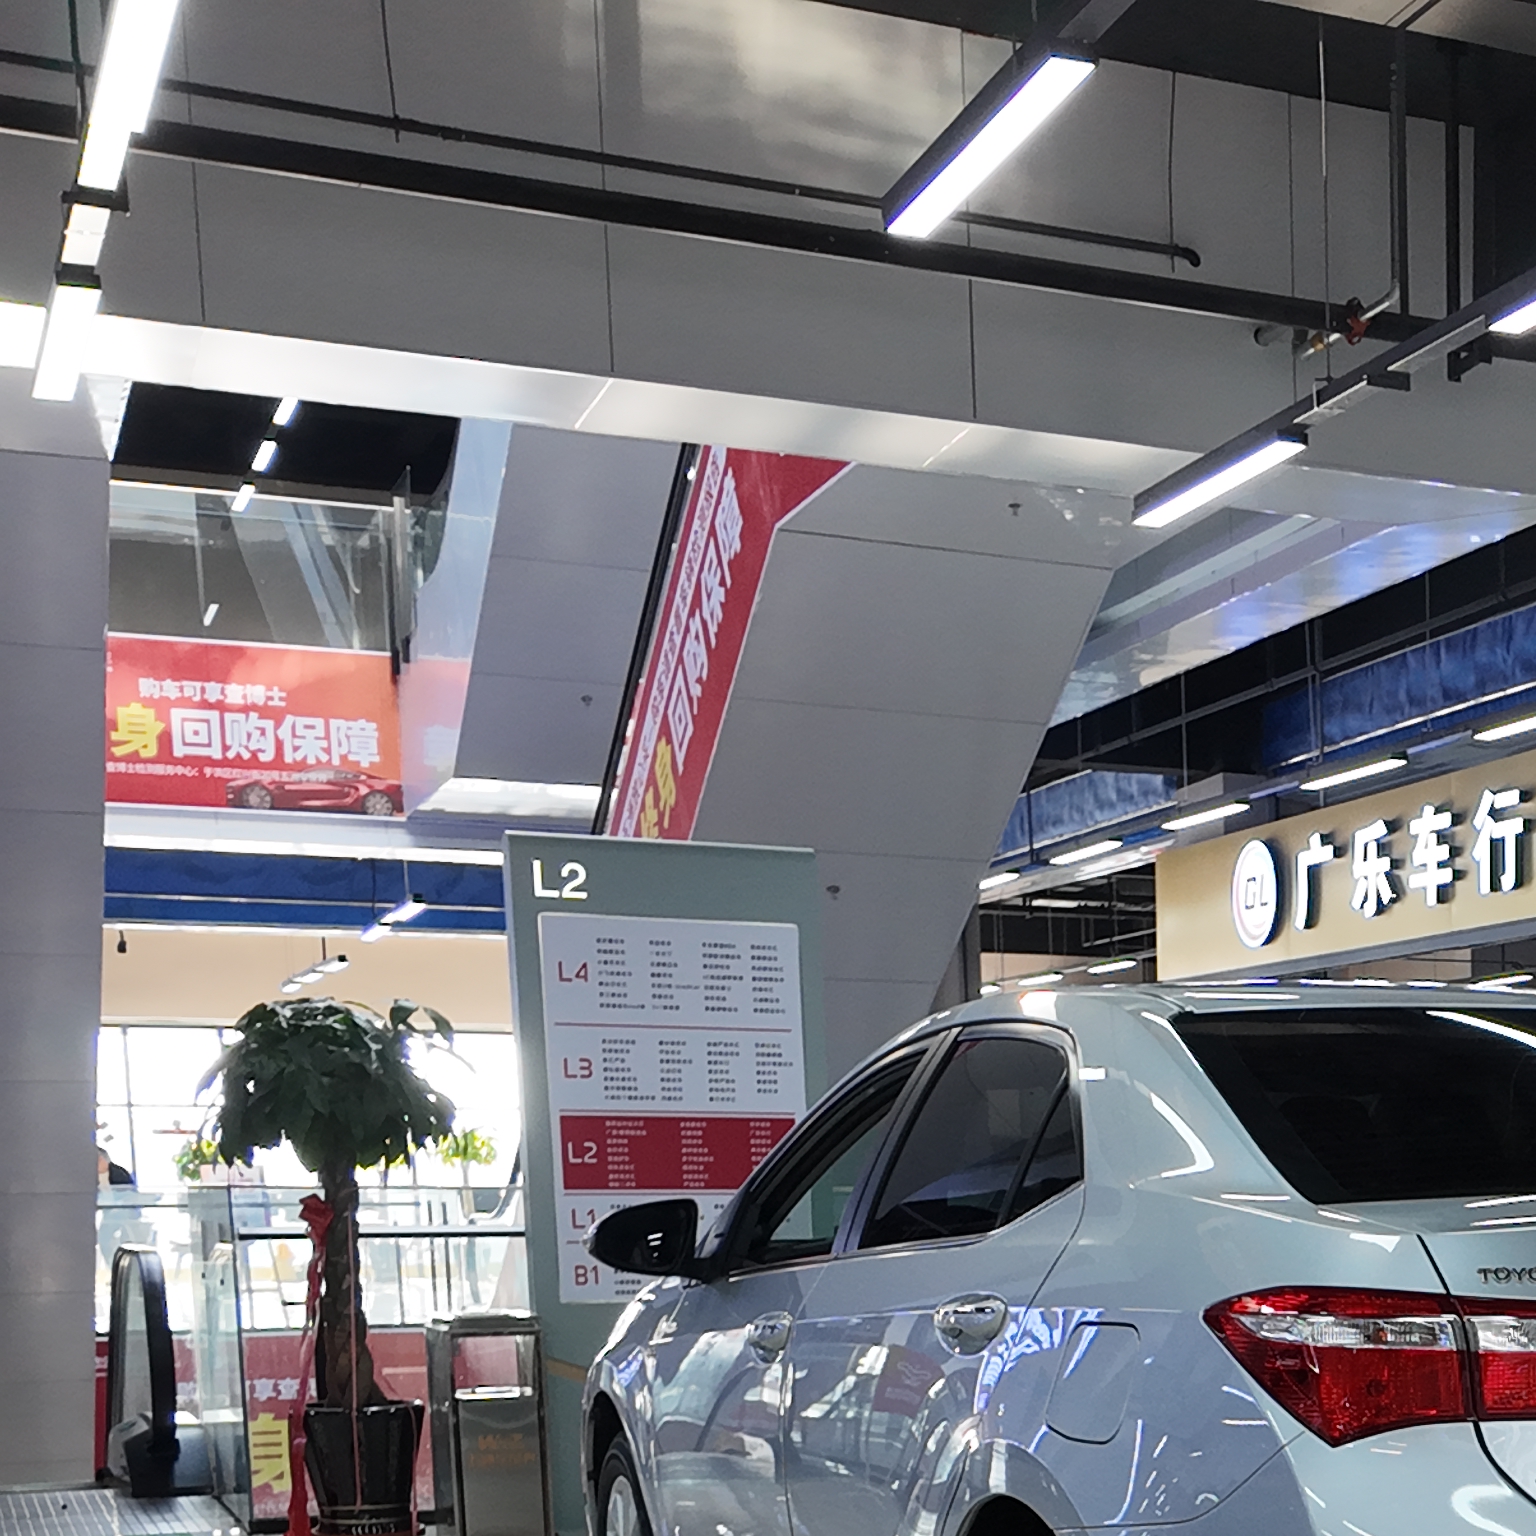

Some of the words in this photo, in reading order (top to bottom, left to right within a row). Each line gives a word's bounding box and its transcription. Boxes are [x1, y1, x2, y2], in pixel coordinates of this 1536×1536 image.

[138, 677, 287, 707] 购车可享查博士
[110, 702, 380, 768] 身回购保障
[1293, 787, 1525, 931] 广乐车行
[532, 858, 588, 899] L2
[558, 961, 589, 983] L4
[563, 1057, 594, 1080] L3
[567, 1141, 598, 1165] L2
[571, 1208, 596, 1230] L1
[574, 1264, 599, 1286] B1
